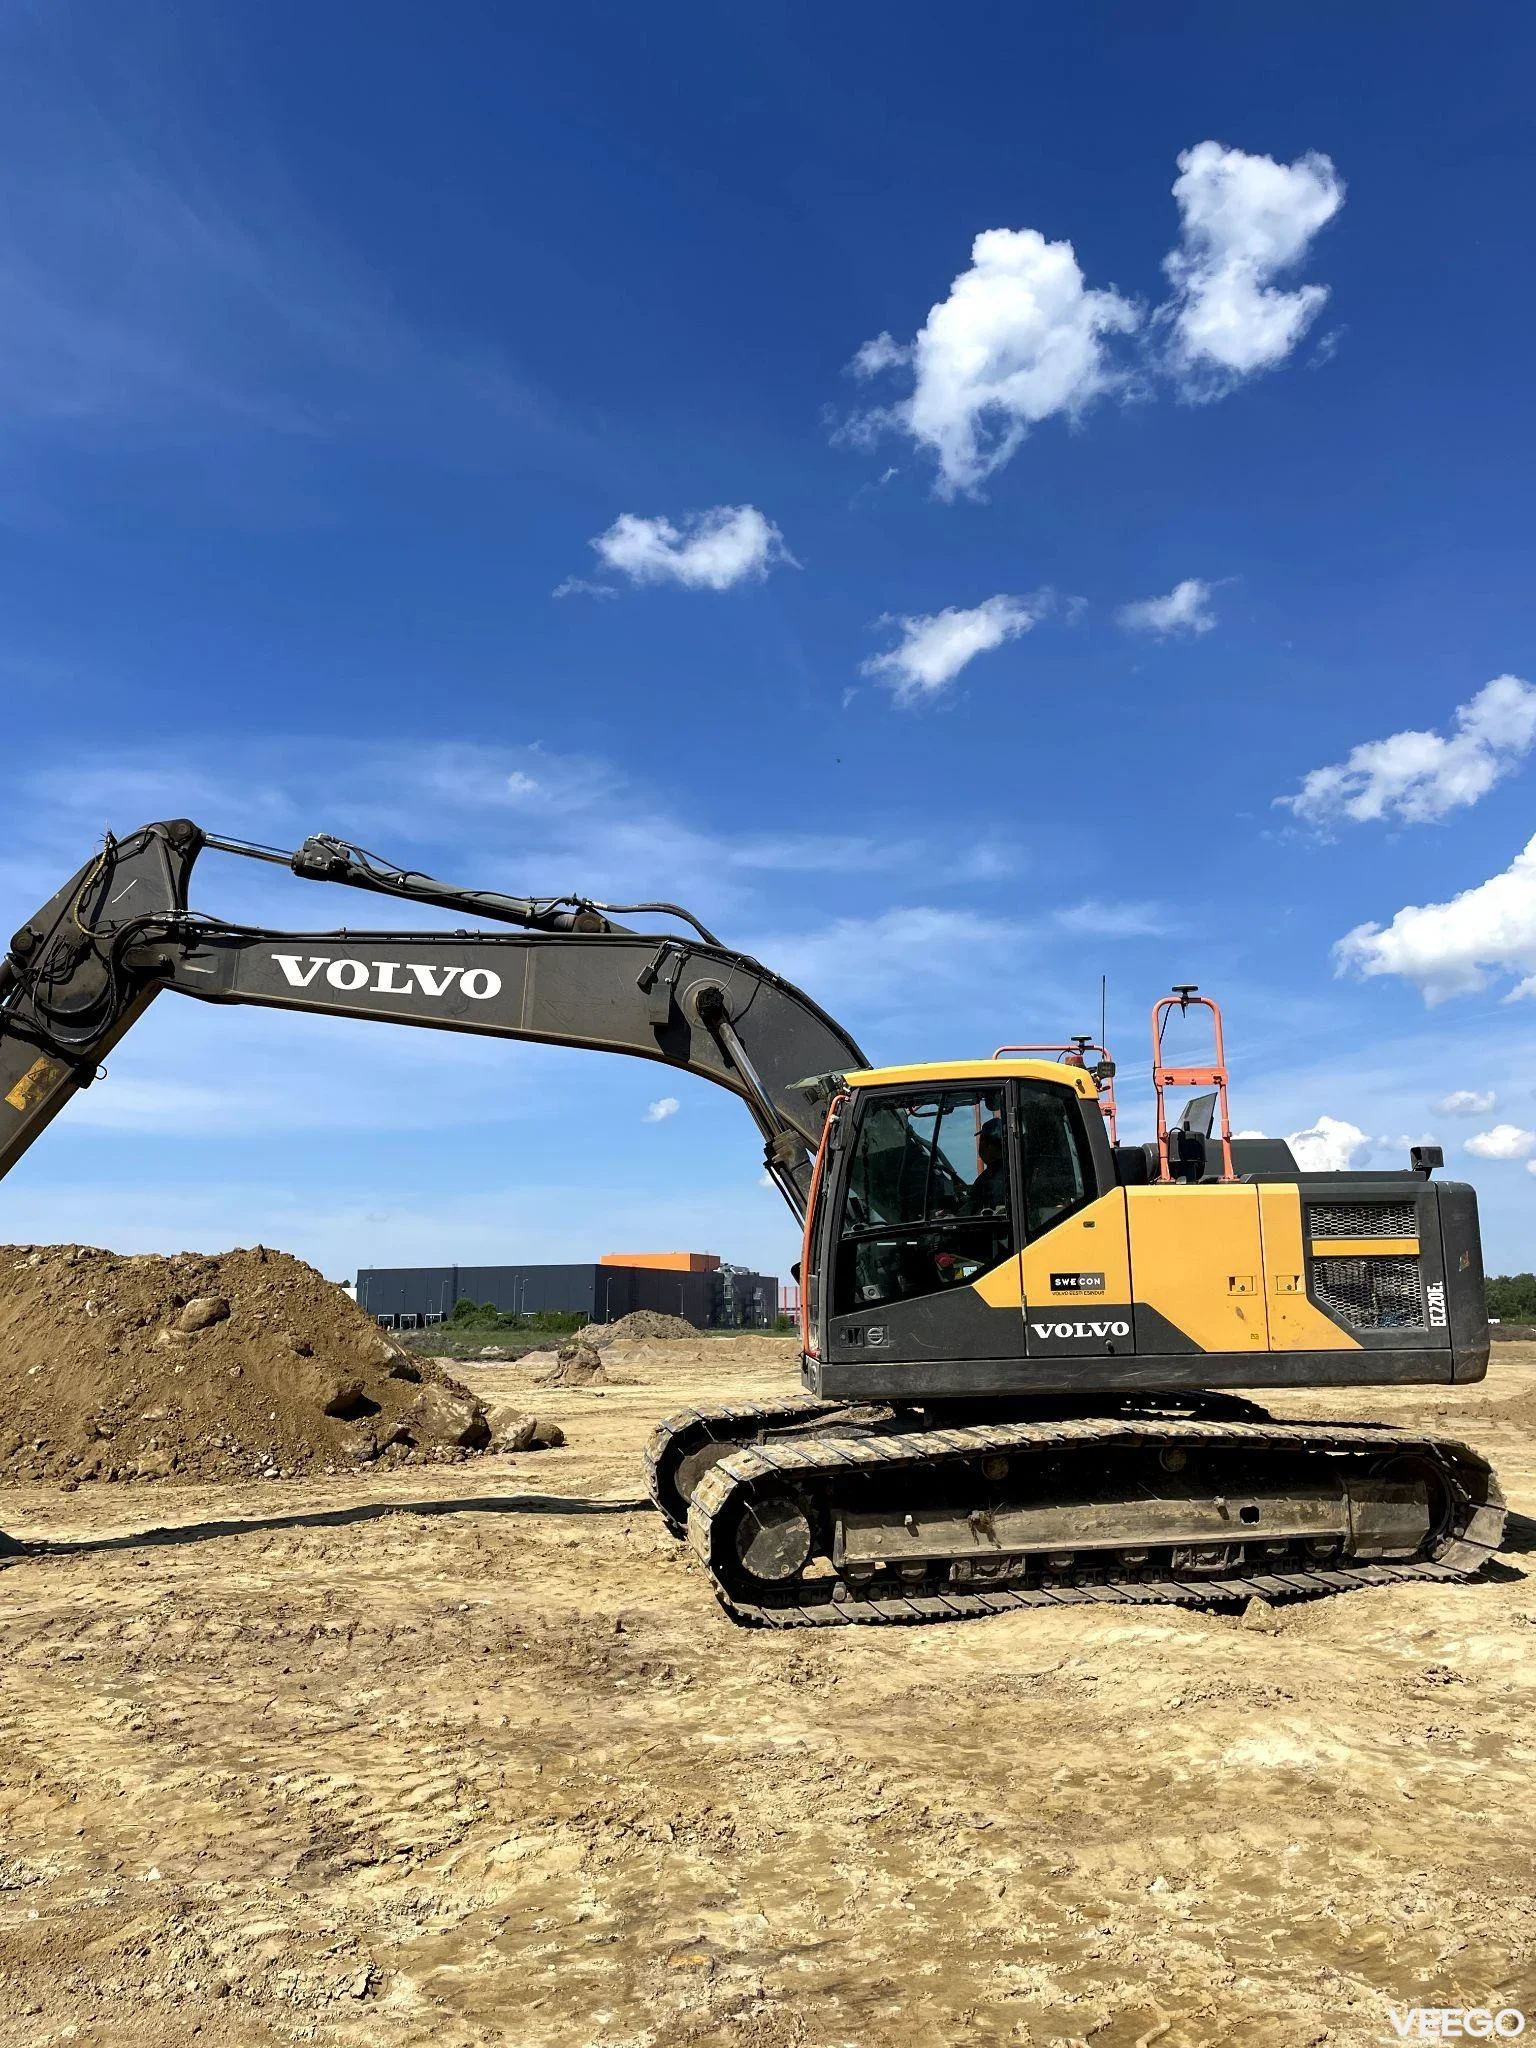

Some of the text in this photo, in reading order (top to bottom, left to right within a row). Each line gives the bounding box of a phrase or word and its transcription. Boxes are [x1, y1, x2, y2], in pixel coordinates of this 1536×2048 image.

[271, 954, 502, 1000] VOLVO
[1055, 1277, 1101, 1286] SWECON
[1030, 1321, 1130, 1339] VOLVO
